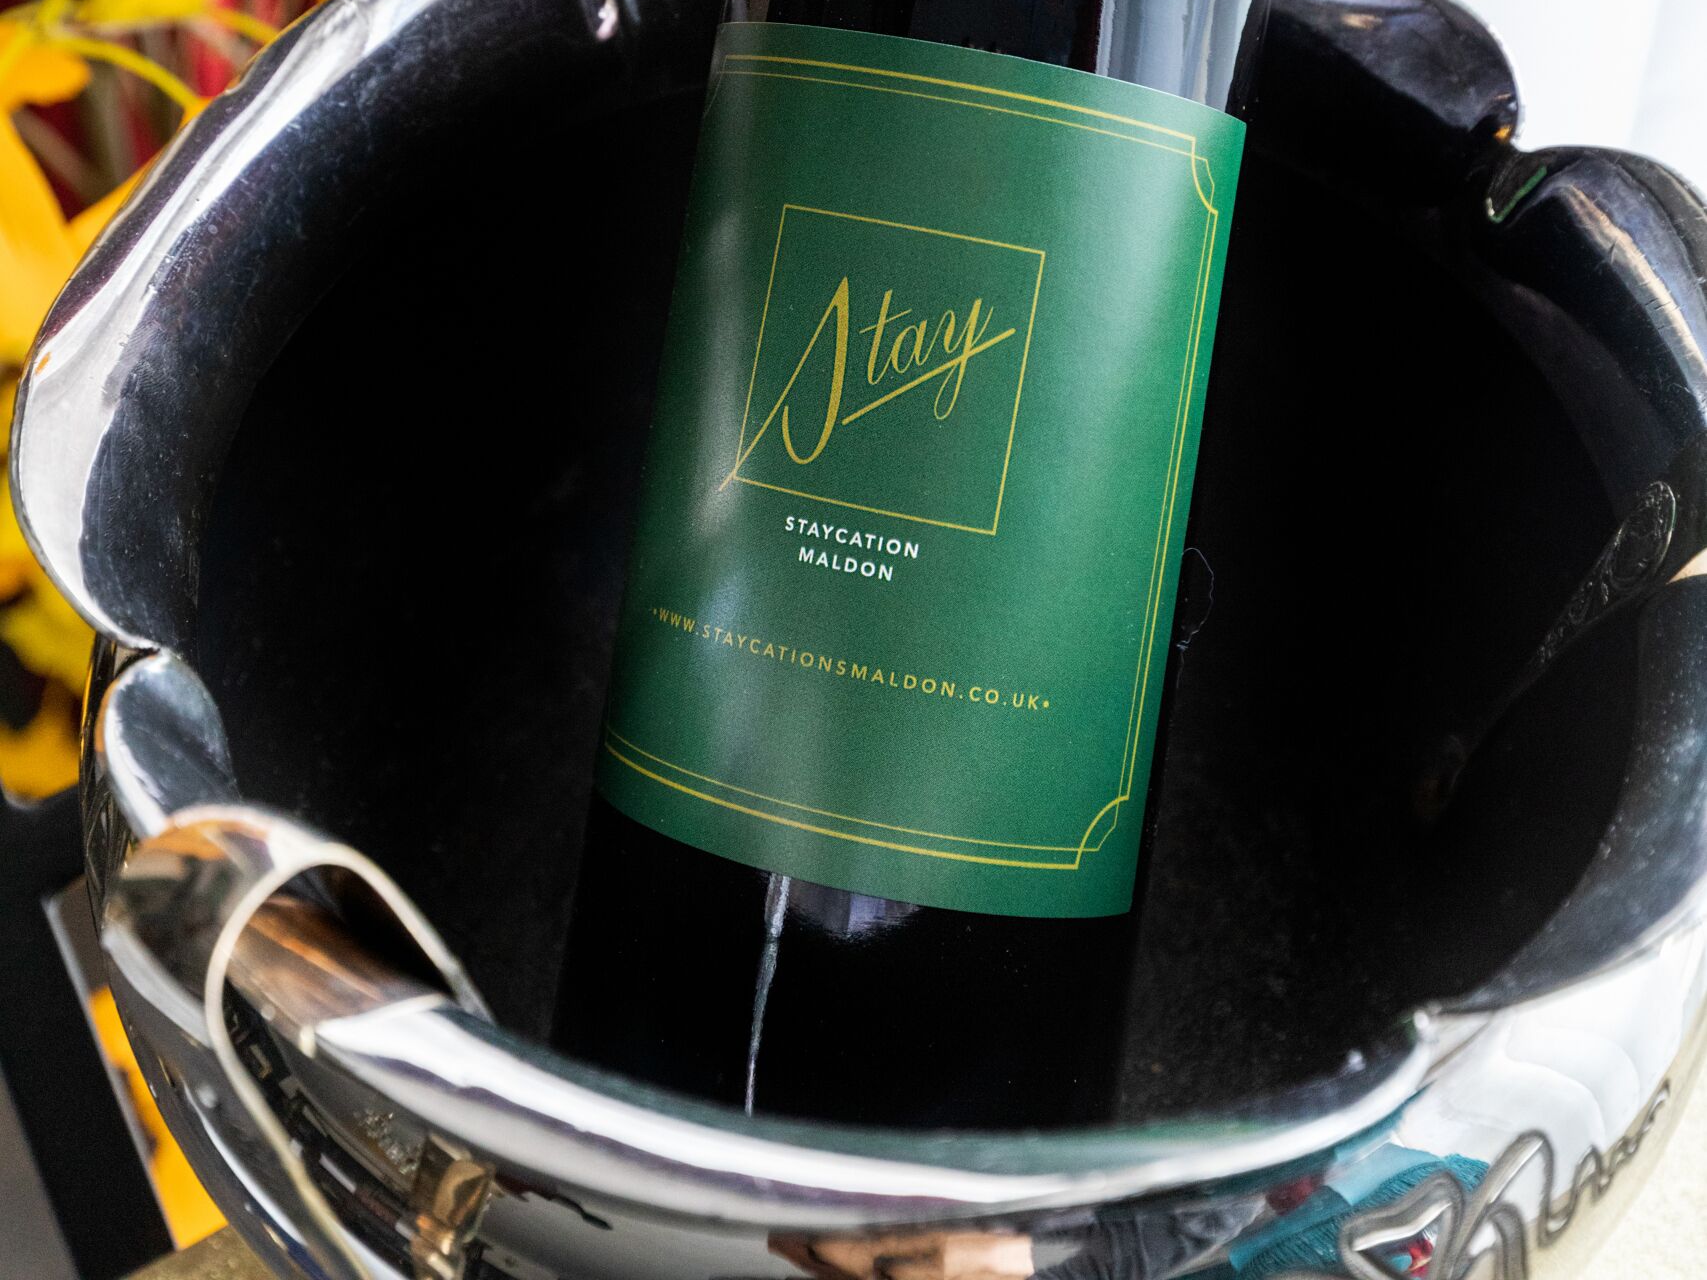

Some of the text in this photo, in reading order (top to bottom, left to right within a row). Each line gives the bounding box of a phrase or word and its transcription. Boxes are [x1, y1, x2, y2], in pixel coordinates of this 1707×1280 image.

[719, 276, 994, 491] Stay
[784, 516, 920, 559] STAYCATION
[798, 546, 894, 582] MALDON
